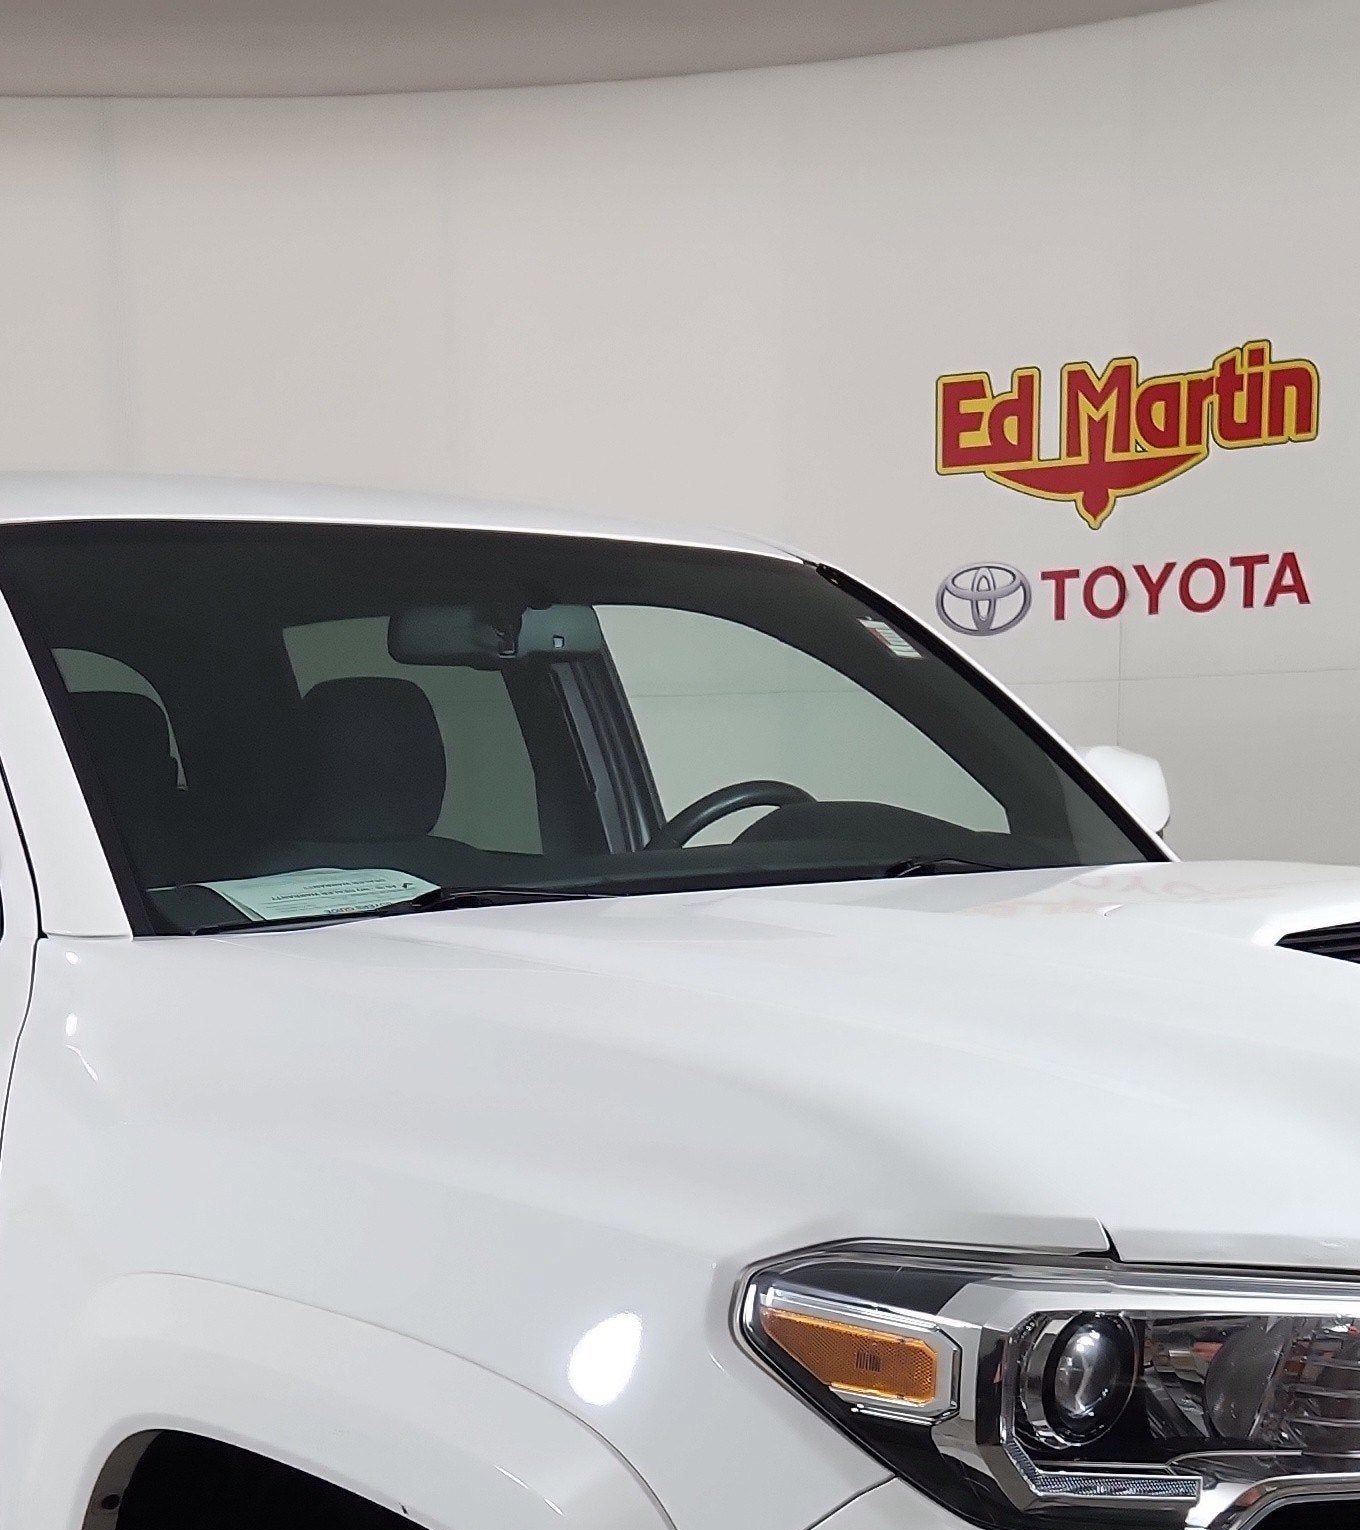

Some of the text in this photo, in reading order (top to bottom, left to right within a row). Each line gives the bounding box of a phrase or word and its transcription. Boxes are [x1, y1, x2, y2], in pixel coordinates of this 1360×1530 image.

[937, 340, 1320, 474] Ed Martin
[1040, 552, 1311, 621] TOYOTA
